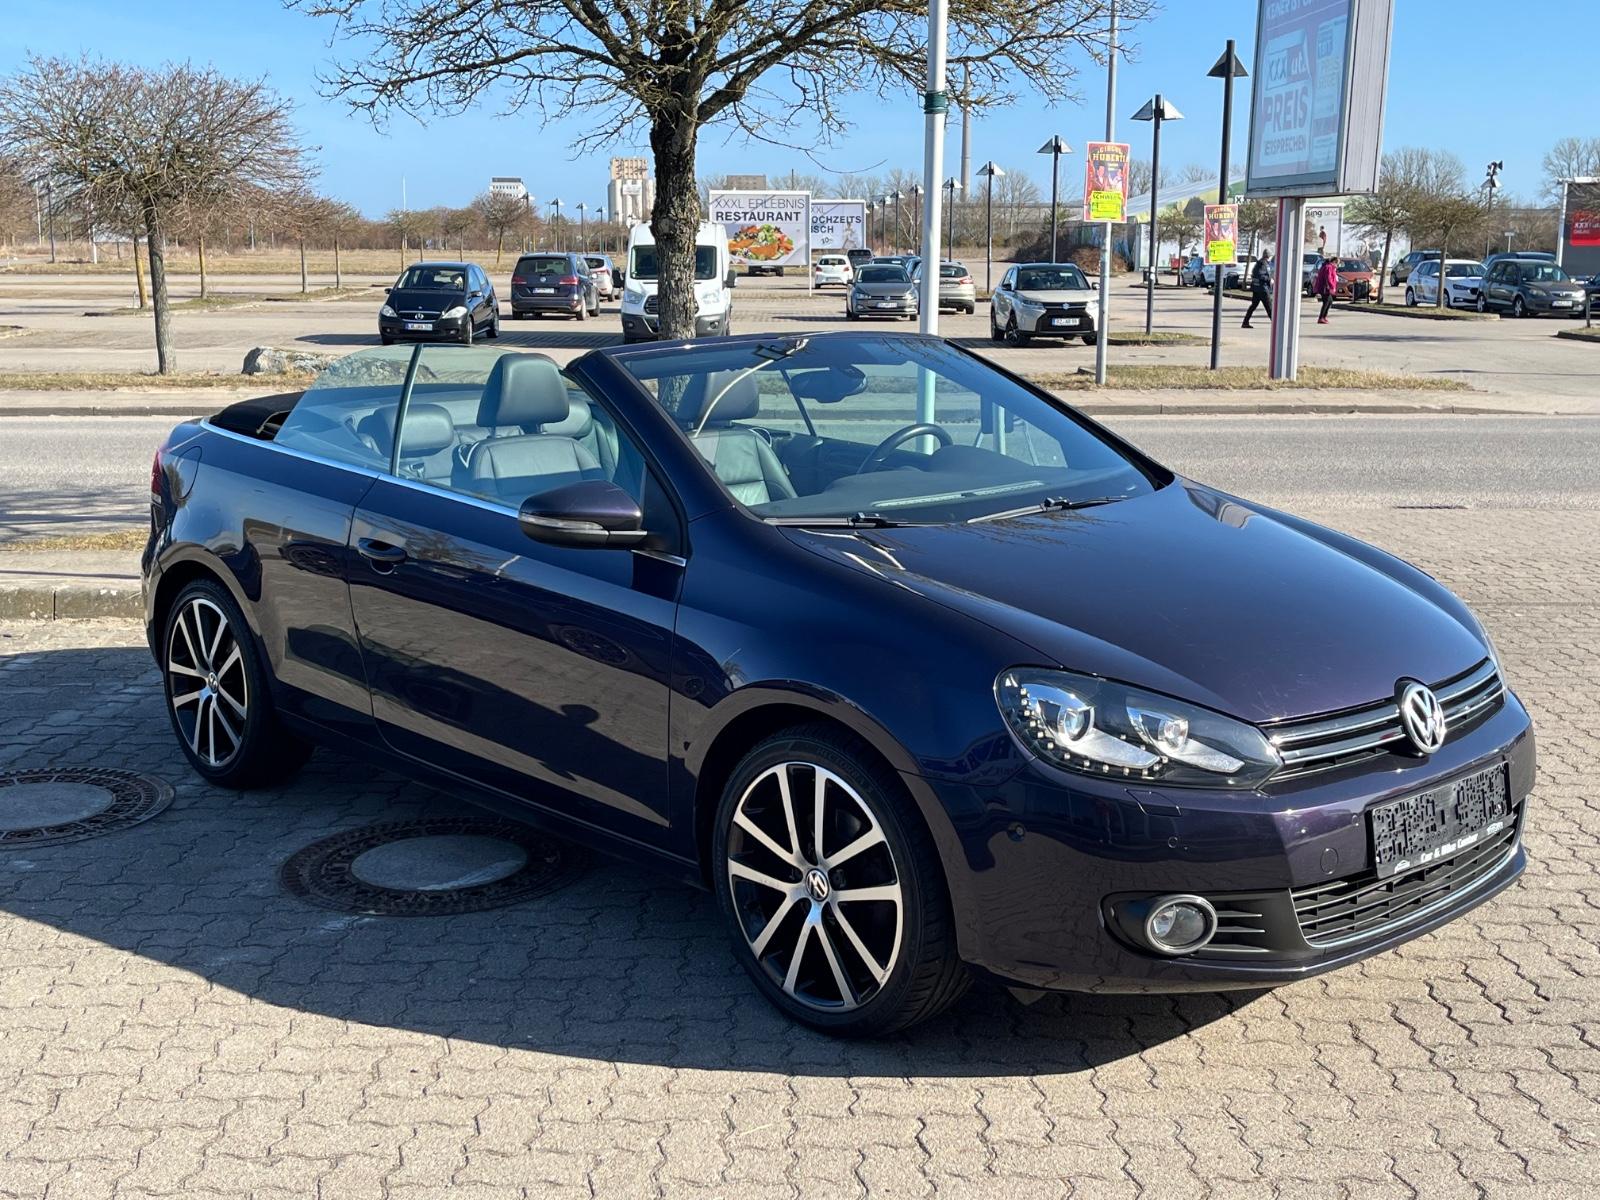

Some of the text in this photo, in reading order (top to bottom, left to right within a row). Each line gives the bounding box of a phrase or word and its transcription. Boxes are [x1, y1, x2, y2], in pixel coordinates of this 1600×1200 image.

[1263, 88, 1309, 133] PREIS
[715, 199, 805, 209] XXXL ERLEBNIS
[716, 211, 801, 222] RESTAURANT
